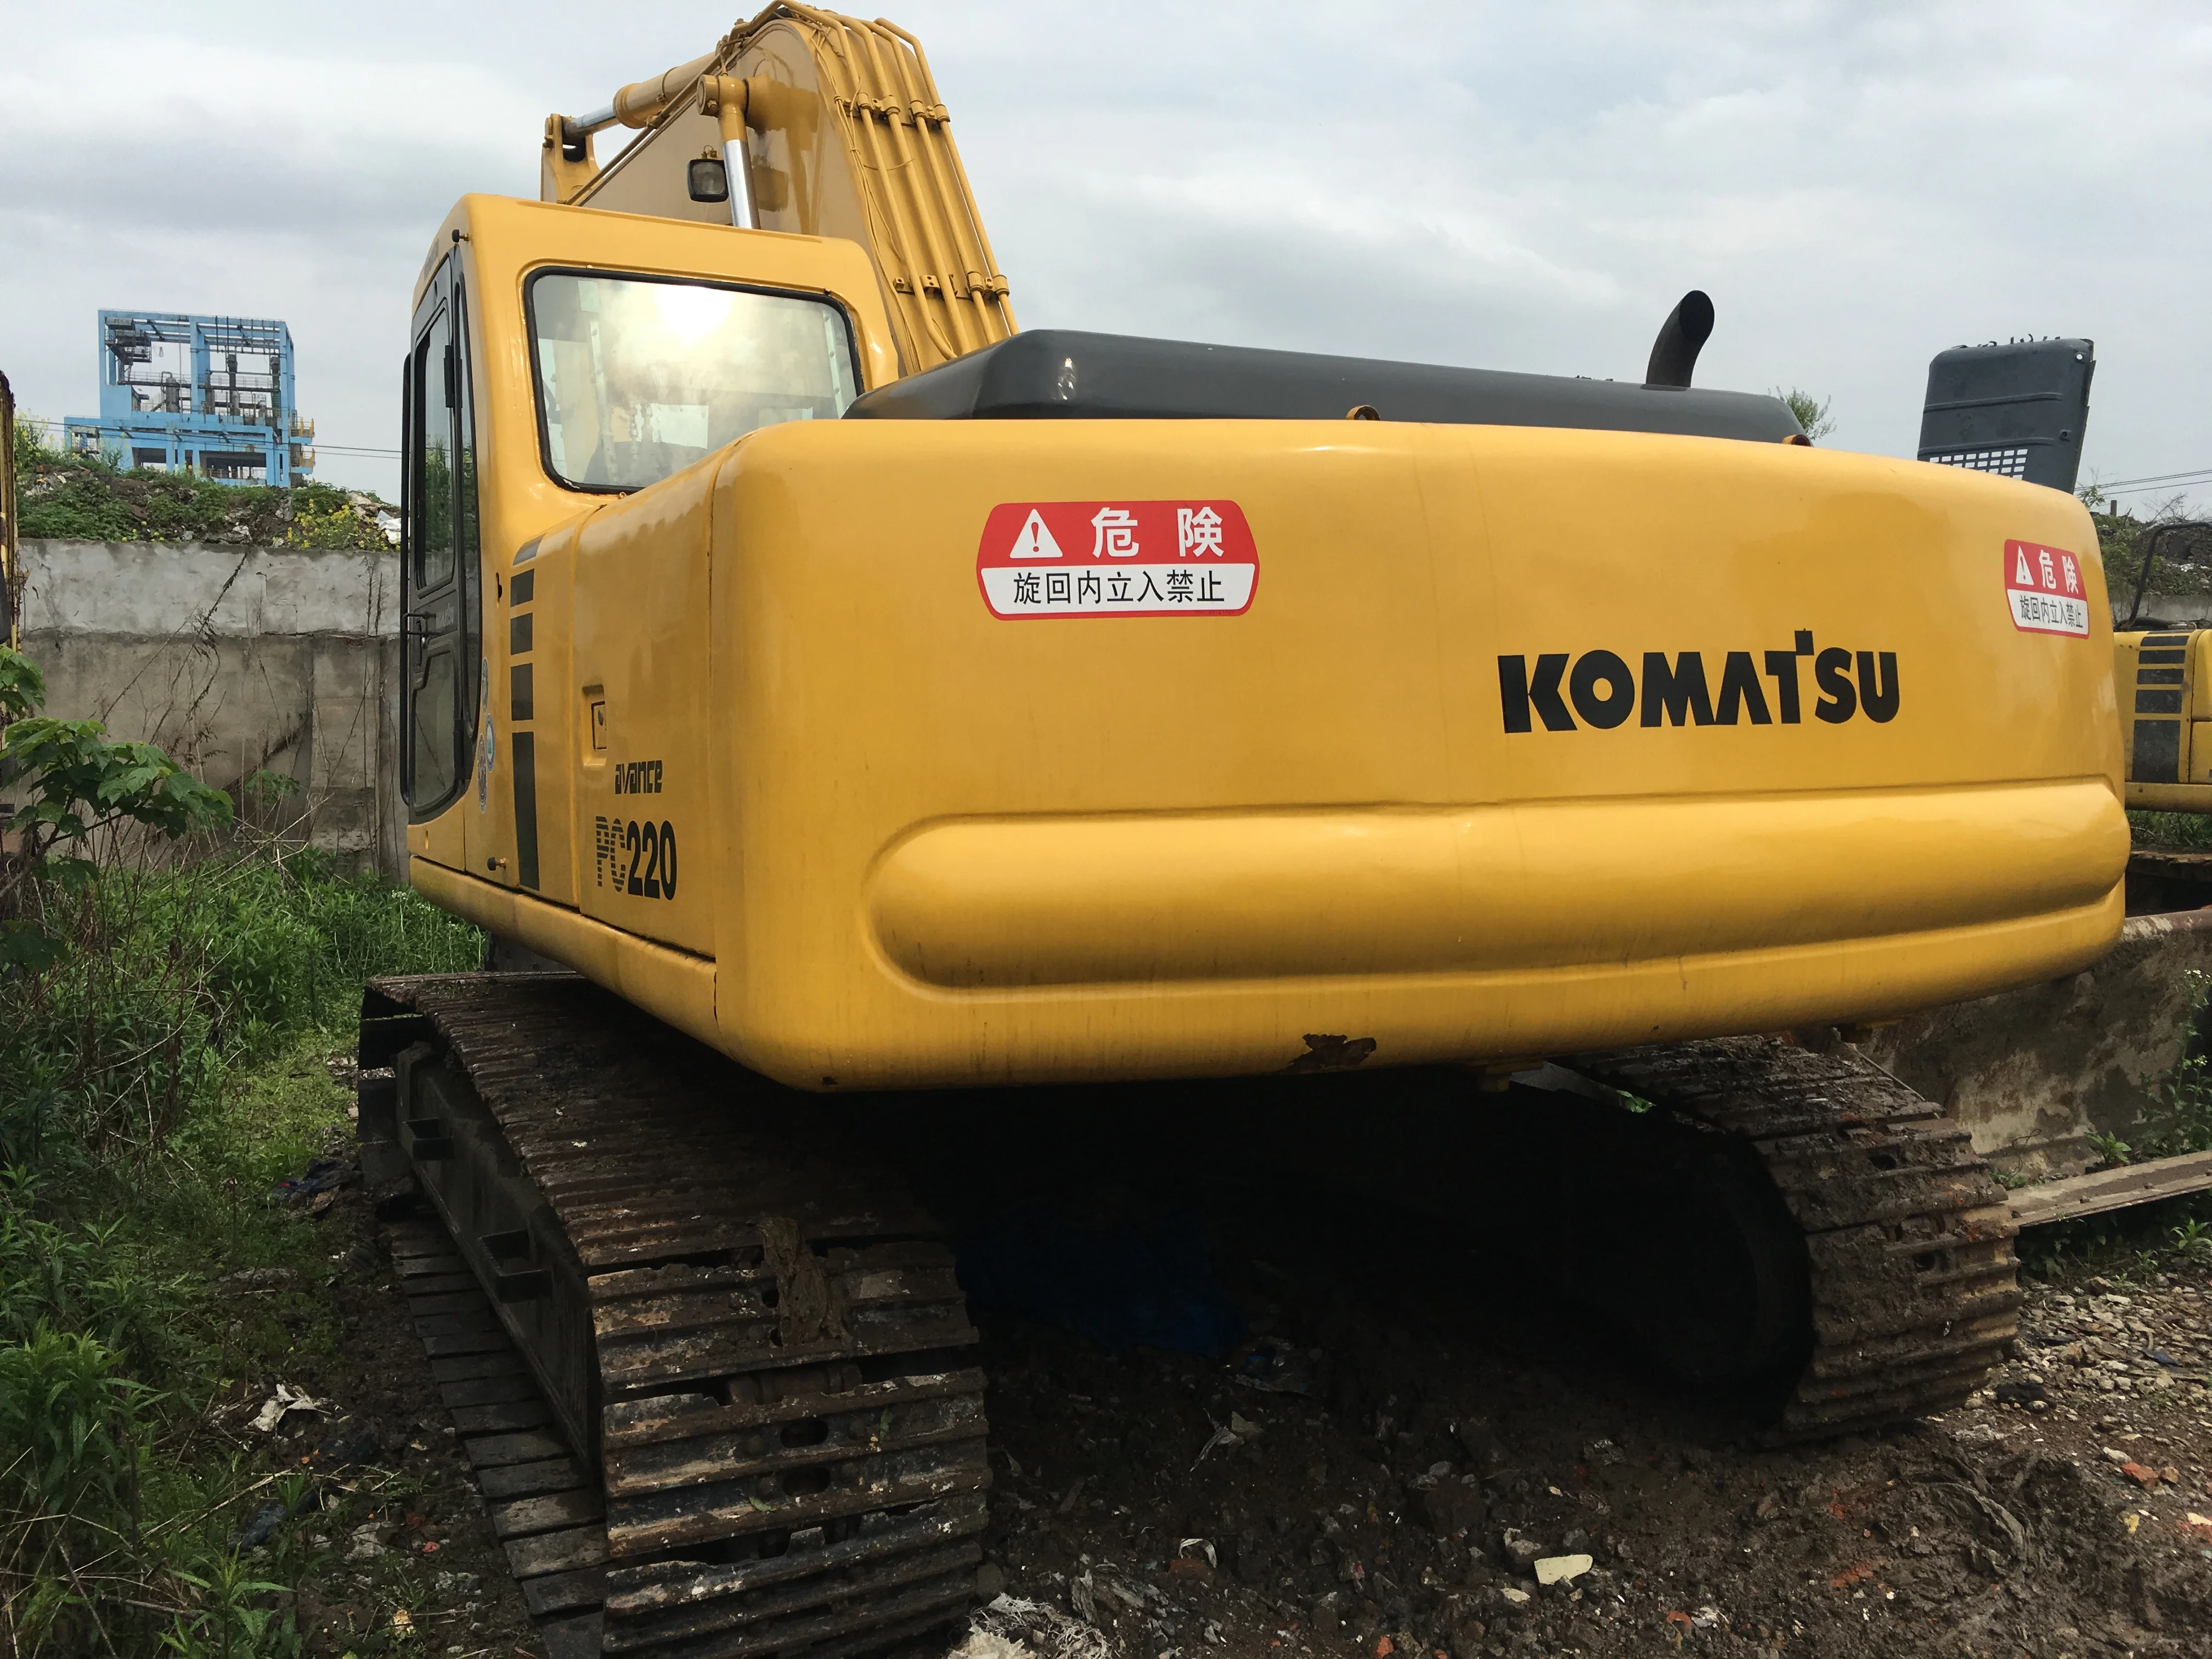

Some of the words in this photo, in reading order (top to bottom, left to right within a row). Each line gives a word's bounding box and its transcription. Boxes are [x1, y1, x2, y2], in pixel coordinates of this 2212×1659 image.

[1090, 506, 1224, 558] 危険
[1013, 569, 1225, 605] 旋回内立入禁止
[2039, 549, 2079, 594] 危険
[2019, 595, 2084, 628] 旋回内立入禁止
[1497, 629, 1900, 734] KOMATSU
[614, 760, 663, 795] avance
[596, 816, 678, 900] PC220
